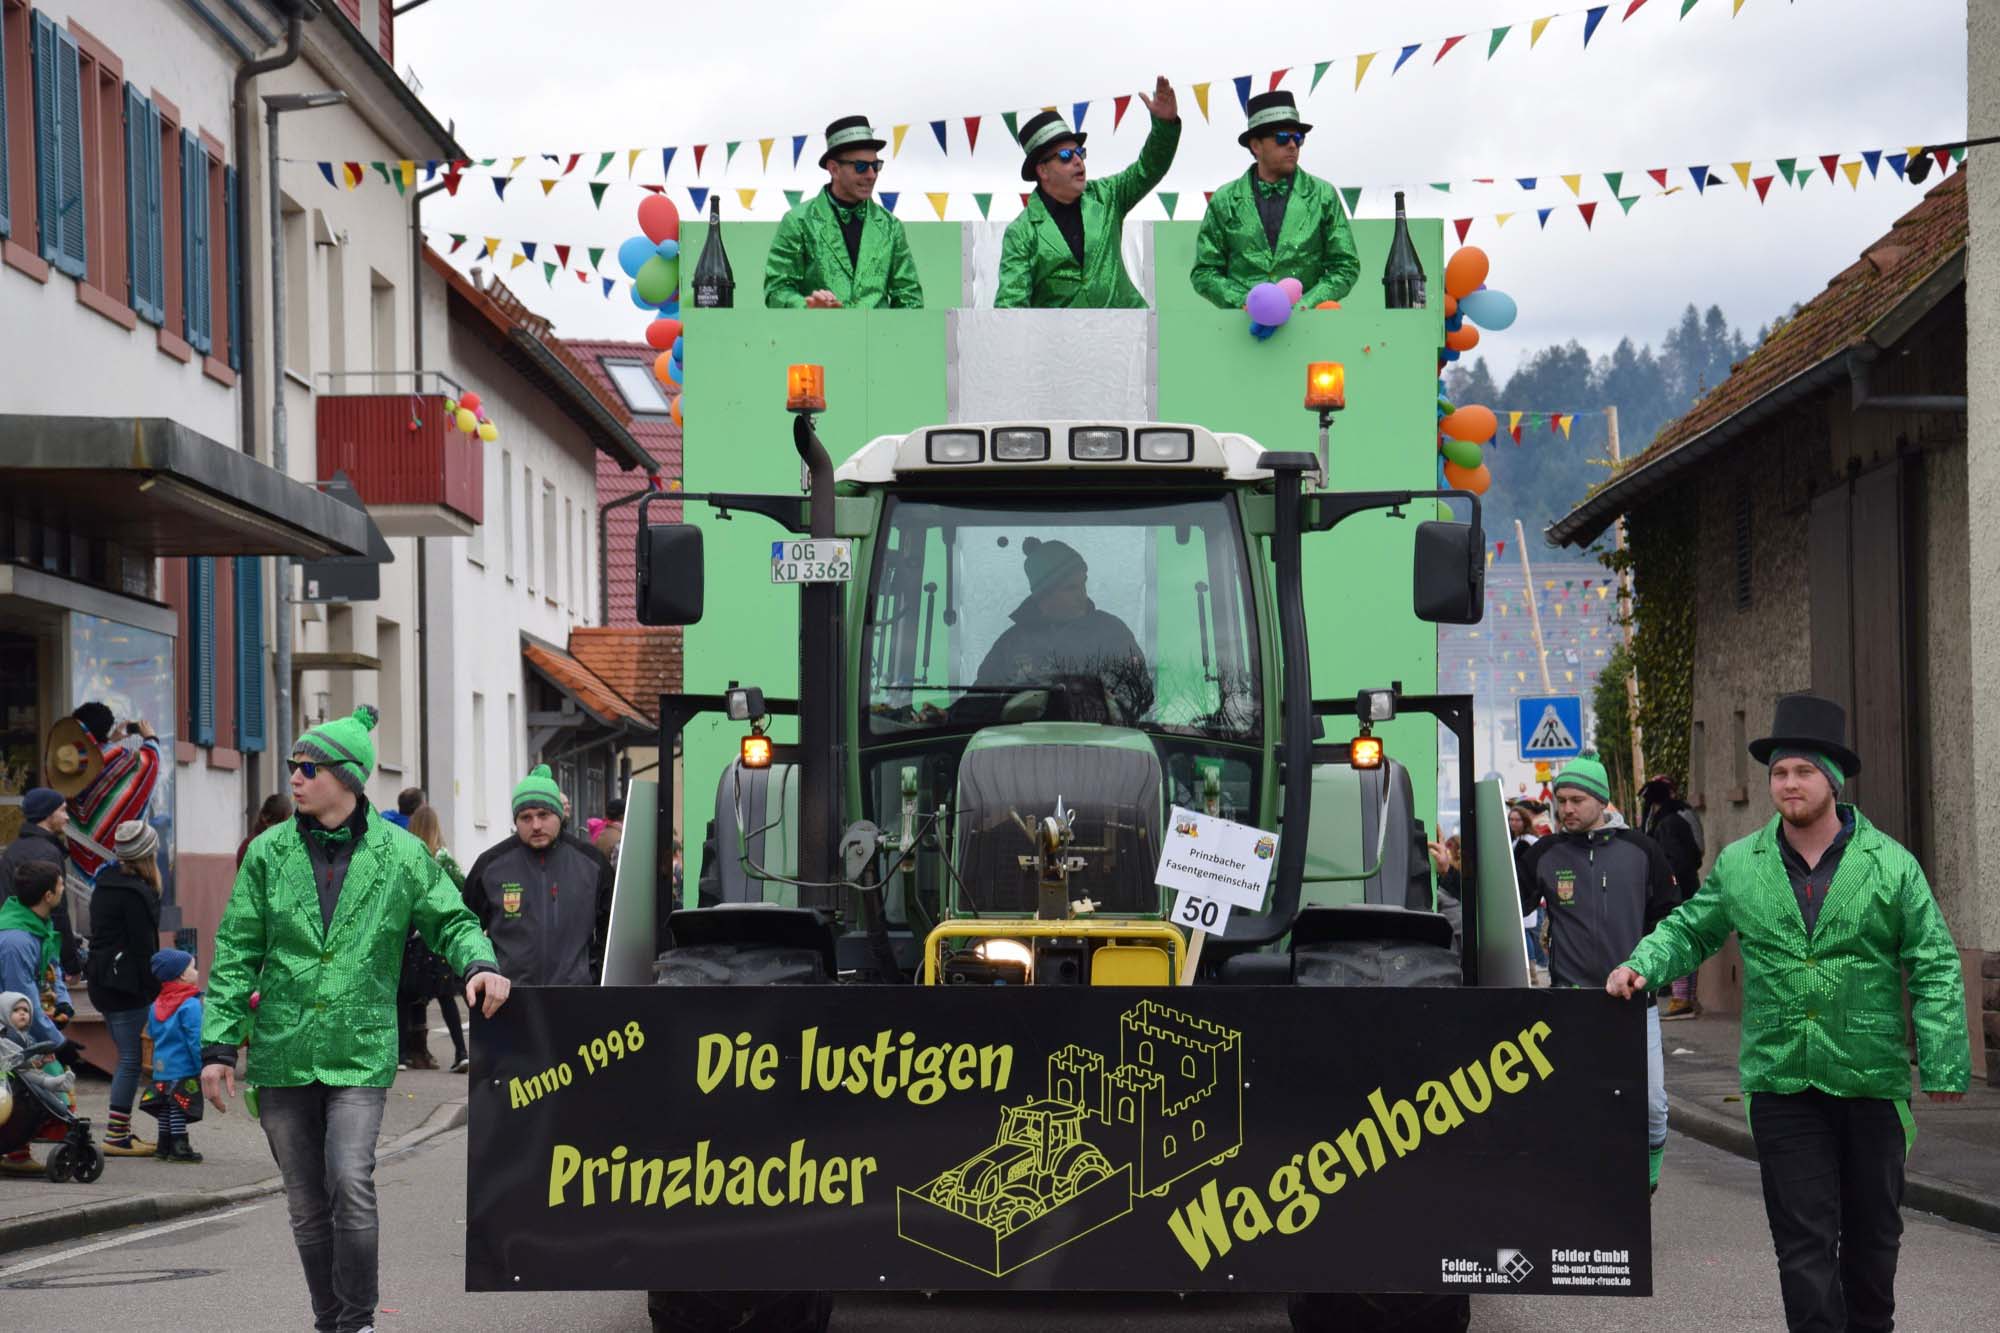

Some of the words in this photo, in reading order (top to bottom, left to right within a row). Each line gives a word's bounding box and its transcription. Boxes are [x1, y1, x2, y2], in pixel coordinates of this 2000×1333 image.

[791, 543, 815, 561] OG
[774, 563, 798, 581] KD
[803, 561, 850, 579] 3362
[1189, 848, 1246, 871] Prinzbacher
[1166, 859, 1261, 892] Fasentgemeinschaft
[1182, 895, 1219, 927] 50
[509, 1062, 573, 1109] Anno
[577, 1020, 645, 1075] 1998
[696, 1032, 779, 1094] Die
[800, 1026, 1014, 1105] lustigen
[1167, 1020, 1554, 1271] Wagenbauer
[548, 1139, 878, 1209] Prinzbacher
[1551, 1248, 1591, 1263] Felder
[1593, 1249, 1629, 1264] GmbH
[1442, 1272, 1482, 1283] bedruckt
[1485, 1272, 1511, 1284] alles.
[1551, 1275, 1631, 1287] www.felder-druck.de
[1586, 1264, 1630, 1275] Textildruck
